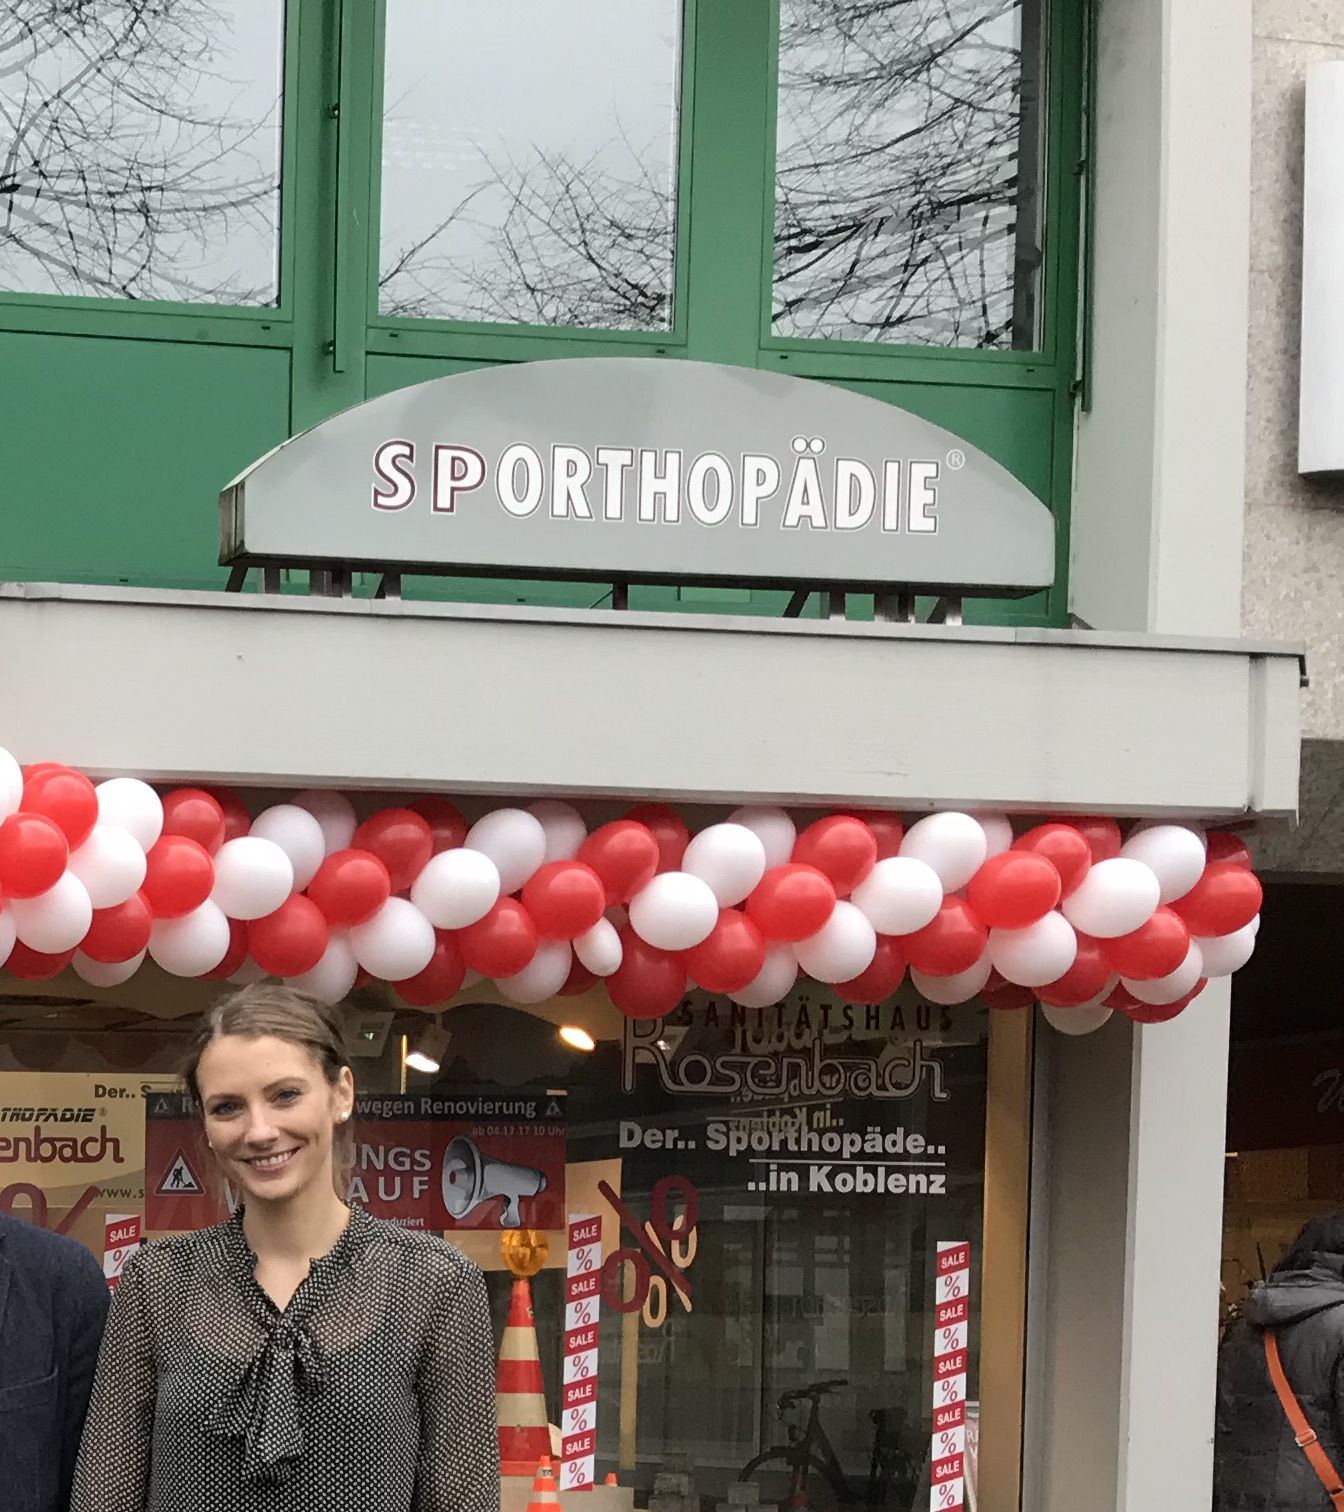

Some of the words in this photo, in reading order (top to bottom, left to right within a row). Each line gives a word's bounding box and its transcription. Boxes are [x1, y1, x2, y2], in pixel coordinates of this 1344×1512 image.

[676, 996, 954, 1032] SANITÄTSHAUS
[622, 1010, 951, 1100] Rosenbach
[356, 1098, 415, 1118] wegen
[420, 1097, 537, 1119] Renovierung
[808, 1165, 947, 1195] Koblenz
[109, 1224, 137, 1243] SALE
[573, 1225, 598, 1242] SALE
[940, 1252, 965, 1269] SALE
[571, 1278, 596, 1295] SALE
[939, 1304, 964, 1322] SALE
[569, 1331, 594, 1348] SALE
[938, 1357, 963, 1374] SALE
[567, 1384, 593, 1402] SALE
[937, 1408, 961, 1426] SALE
[566, 1437, 591, 1455] SALE
[935, 1460, 960, 1477] SALE
